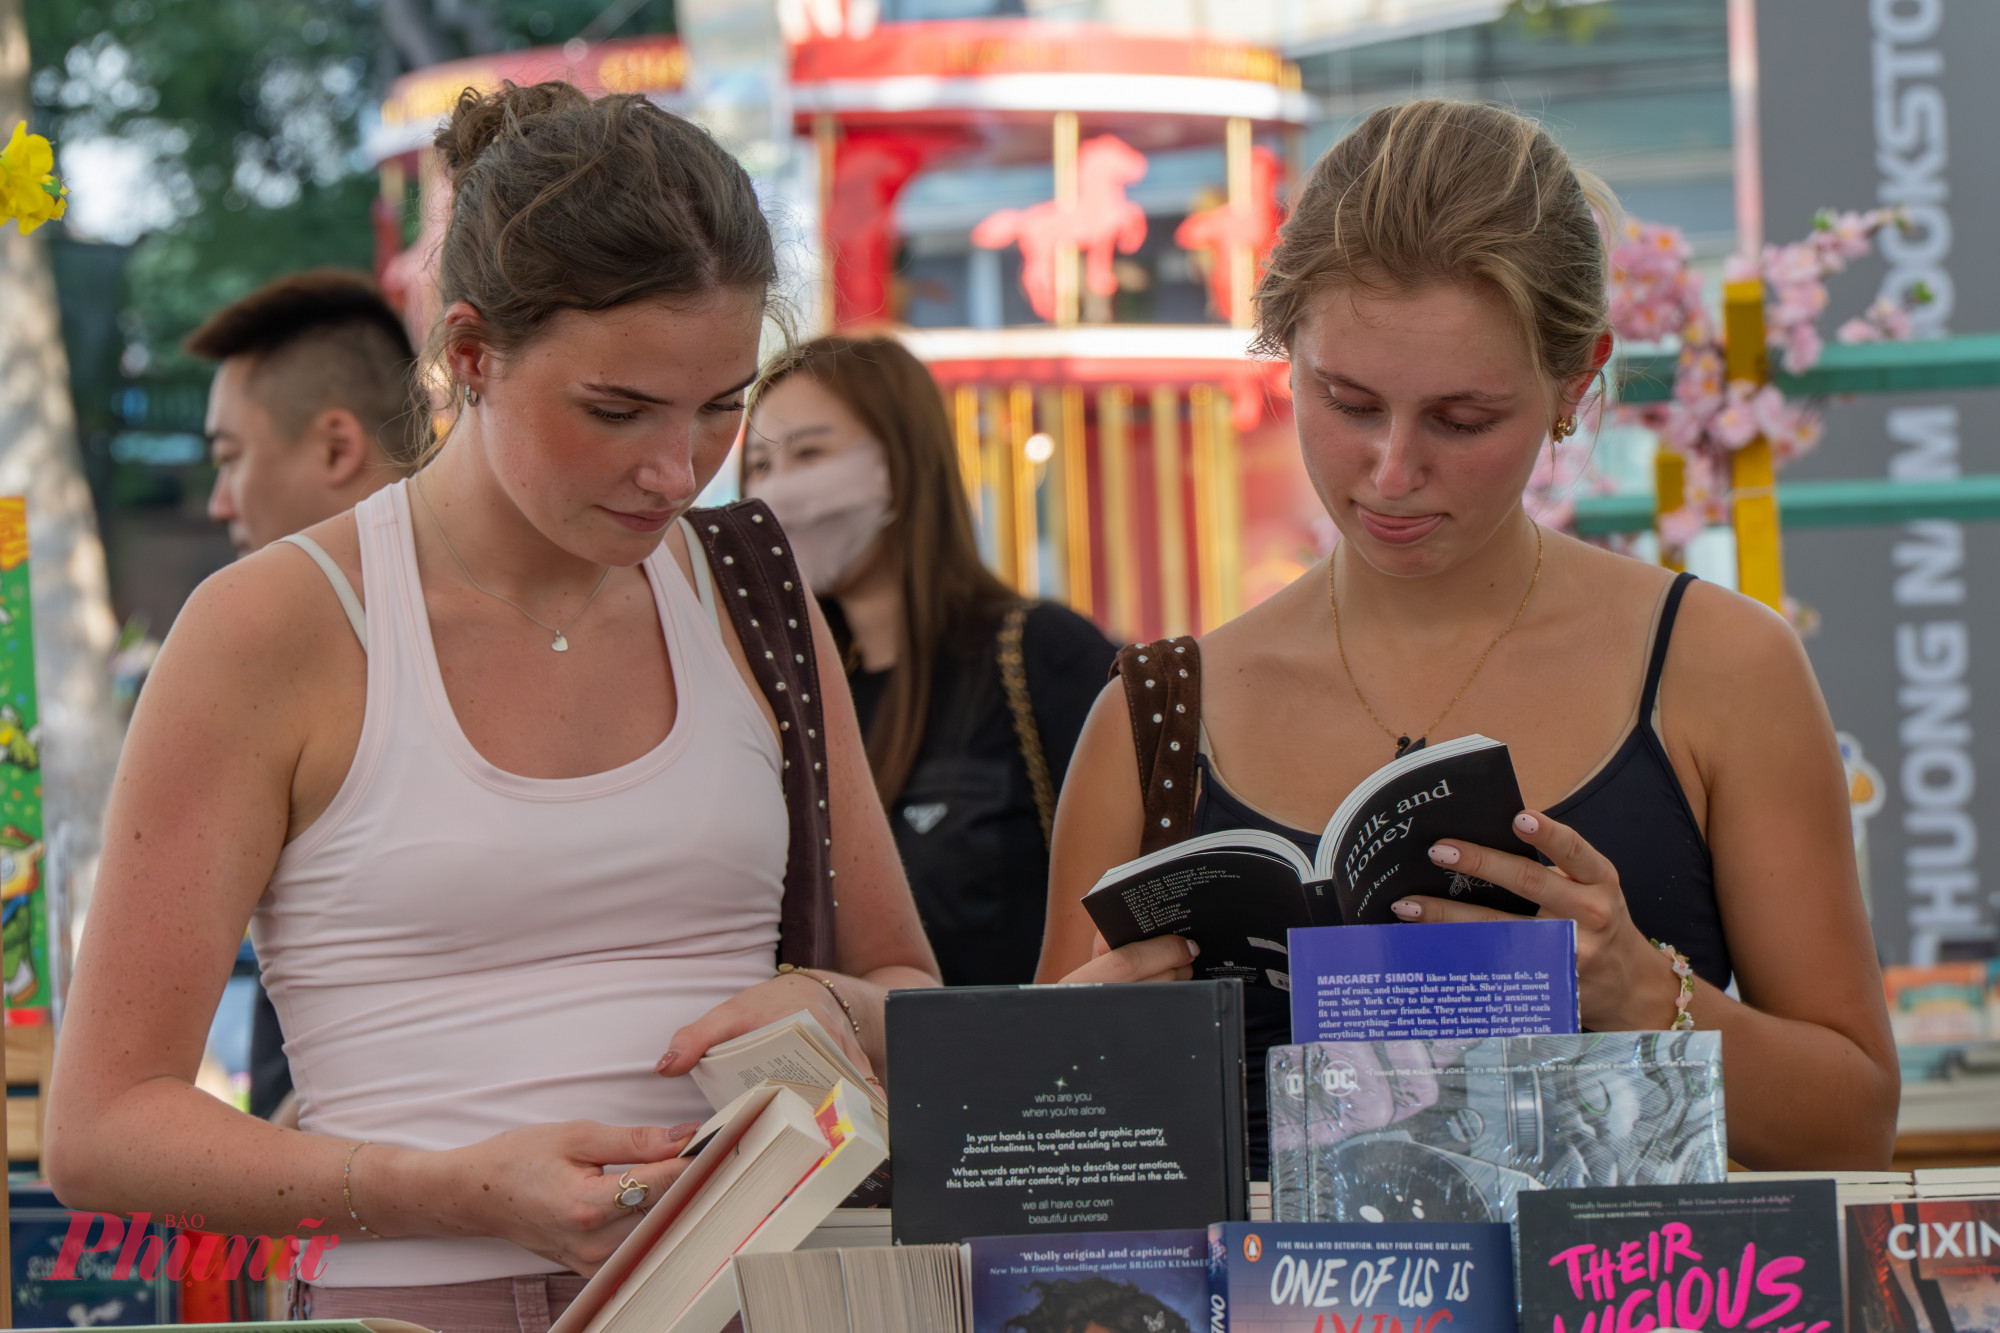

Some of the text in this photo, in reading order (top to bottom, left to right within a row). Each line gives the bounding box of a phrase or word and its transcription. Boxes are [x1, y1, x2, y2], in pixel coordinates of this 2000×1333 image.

[1868, 0, 1954, 338] OOKSTO
[1893, 618, 1980, 969] HUONG
[1345, 779, 1453, 874] milk and
[1348, 816, 1414, 892] honey
[1357, 863, 1400, 918] rupi kaur
[1317, 971, 1549, 985] MARGARET SIMON likes long hair, tuna fish, the
[1318, 988, 1340, 996] smell
[1342, 987, 1351, 996] of
[1352, 987, 1372, 996] rain,
[1374, 986, 1390, 995] and
[1392, 985, 1419, 996] things
[1420, 985, 1438, 993] that
[1456, 984, 1477, 994] pink.
[1480, 983, 1502, 992] She's
[1503, 982, 1520, 993] just
[1522, 982, 1549, 990] moved
[1318, 992, 1550, 1007] from New York City to the suburbs and is anxious to
[1318, 1009, 1328, 1017] fit
[1330, 1009, 1340, 1017] in
[1342, 1008, 1361, 1017] with
[1363, 1008, 1378, 1016] her
[1400, 1006, 1431, 1015] friends.
[1434, 1005, 1455, 1016] They
[1485, 1004, 1512, 1015] they'll
[1514, 1003, 1529, 1012] tell
[1530, 1003, 1551, 1011] each
[1318, 1014, 1551, 1029] other everything—first bras, first kisses, first periods—
[1319, 1029, 1366, 1040] everything.
[1369, 1029, 1384, 1037] But
[1411, 1027, 1438, 1038] things
[1456, 1027, 1472, 1037] just
[1475, 1026, 1488, 1035] too
[1491, 1025, 1521, 1036] private
[1523, 1025, 1532, 1033] to
[1534, 1025, 1551, 1033] talk
[1291, 1073, 1304, 1093] D
[1323, 1068, 1354, 1089] DC
[1034, 1093, 1056, 1102] who
[1073, 1094, 1092, 1103] you
[1022, 1105, 1105, 1118] when you're alone
[966, 1133, 975, 1142] In
[977, 1134, 996, 1144] your
[999, 1131, 1025, 1141] hands
[1027, 1131, 1034, 1140] is
[1045, 1129, 1086, 1139] collection
[1088, 1129, 1097, 1138] of
[1099, 1128, 1132, 1140] graphic
[1134, 1127, 1162, 1138] poetry
[963, 1144, 988, 1153] about
[990, 1142, 1034, 1153] loneliness,
[1037, 1141, 1055, 1151] love
[1057, 1141, 1074, 1150] and
[1077, 1139, 1110, 1151] existing
[1112, 1139, 1120, 1148] in
[1139, 1137, 1166, 1147] world.
[952, 1167, 978, 1176] When
[980, 1166, 1007, 1175] words
[1009, 1165, 1035, 1174] aren't
[1037, 1163, 1070, 1175] enough
[1071, 1163, 1081, 1172] to
[1082, 1162, 1120, 1171] describe
[1138, 1160, 1180, 1171] emotions,
[946, 1179, 961, 1188] this
[963, 1178, 986, 1187] book
[987, 1177, 1003, 1186] will
[1004, 1176, 1026, 1186] offer
[1028, 1175, 1064, 1186] comfort,
[1066, 1175, 1080, 1185] joy
[1082, 1173, 1099, 1183] and
[1109, 1172, 1135, 1182] friend
[1137, 1172, 1146, 1181] in
[1147, 1171, 1162, 1180] the
[1163, 1170, 1186, 1180] dark.
[1038, 1200, 1048, 1209] all
[1050, 1200, 1073, 1209] have
[1093, 1199, 1114, 1207] own
[1028, 1212, 1108, 1224] beautiful universe
[1019, 1245, 1192, 1262] 'Wholly original and captivating'
[1276, 1242, 1475, 1250] FIVE WALK INTO DETENTION. ONLY FOUR COME OUT ALIVE.
[1548, 1221, 1703, 1302] THEIR
[1270, 1254, 1474, 1308] ONE OF US IS
